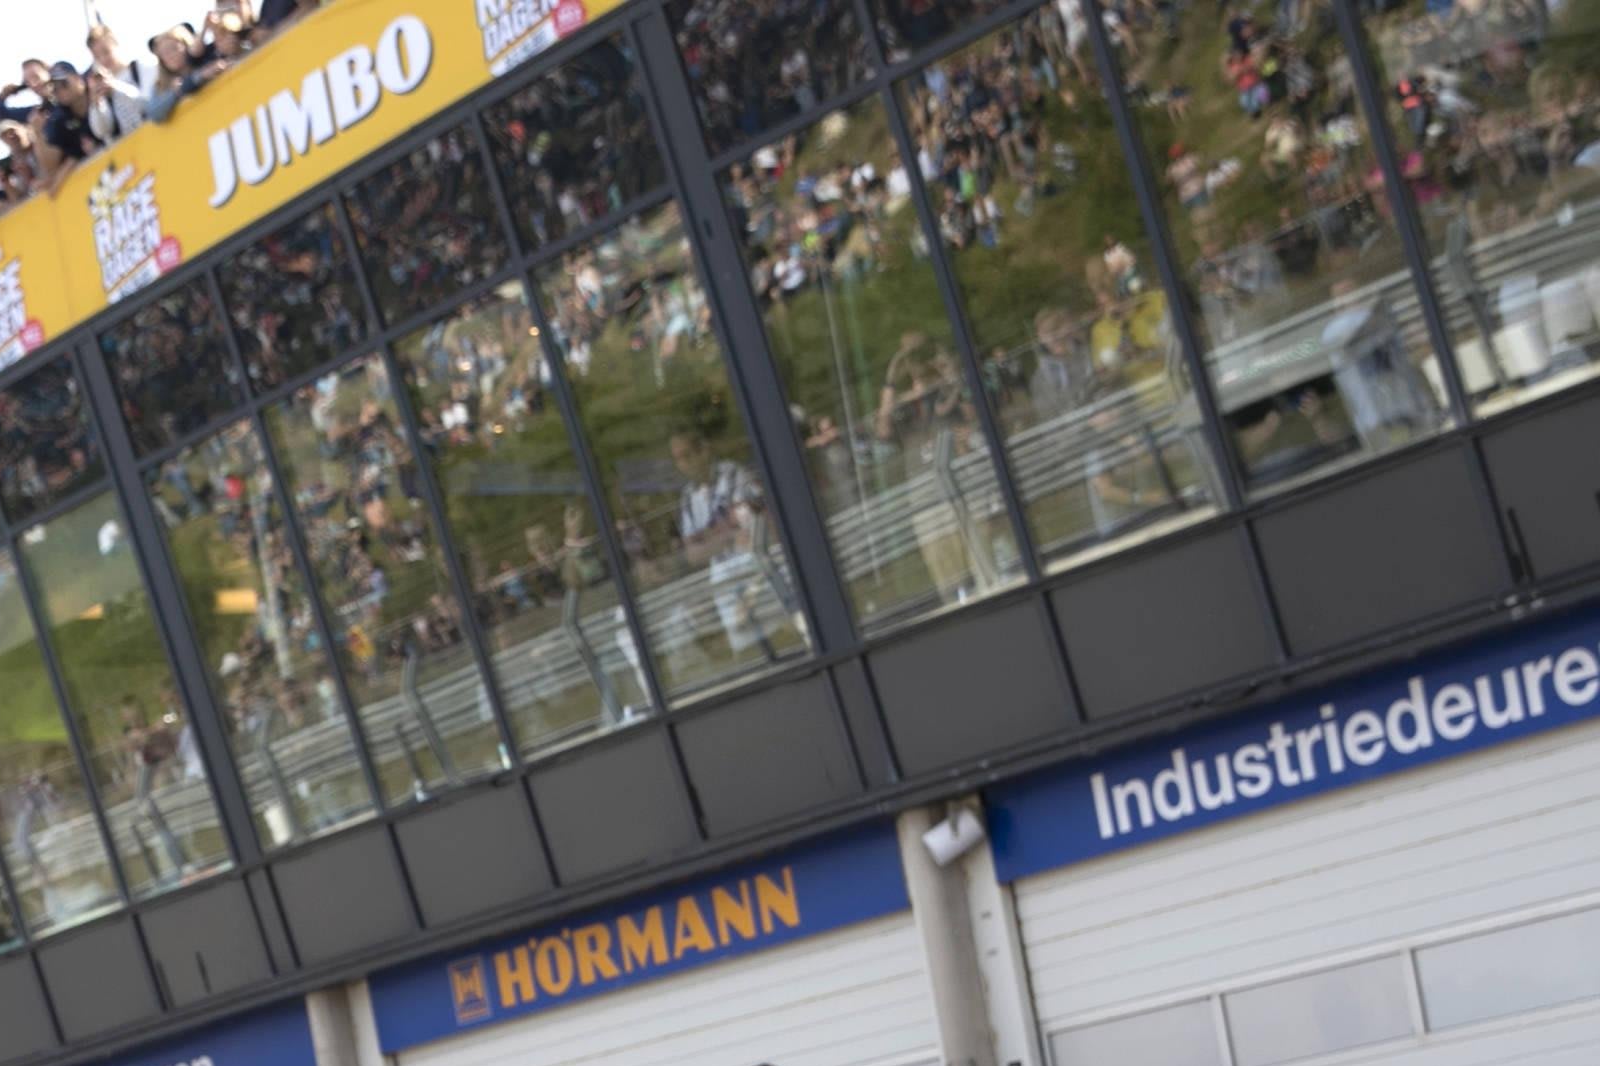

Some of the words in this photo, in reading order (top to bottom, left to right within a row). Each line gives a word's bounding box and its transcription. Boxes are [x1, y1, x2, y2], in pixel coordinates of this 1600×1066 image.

[208, 14, 433, 208] JUMBO
[1090, 642, 1600, 839] Industriedeure
[494, 865, 800, 1009] HÖRMANN
